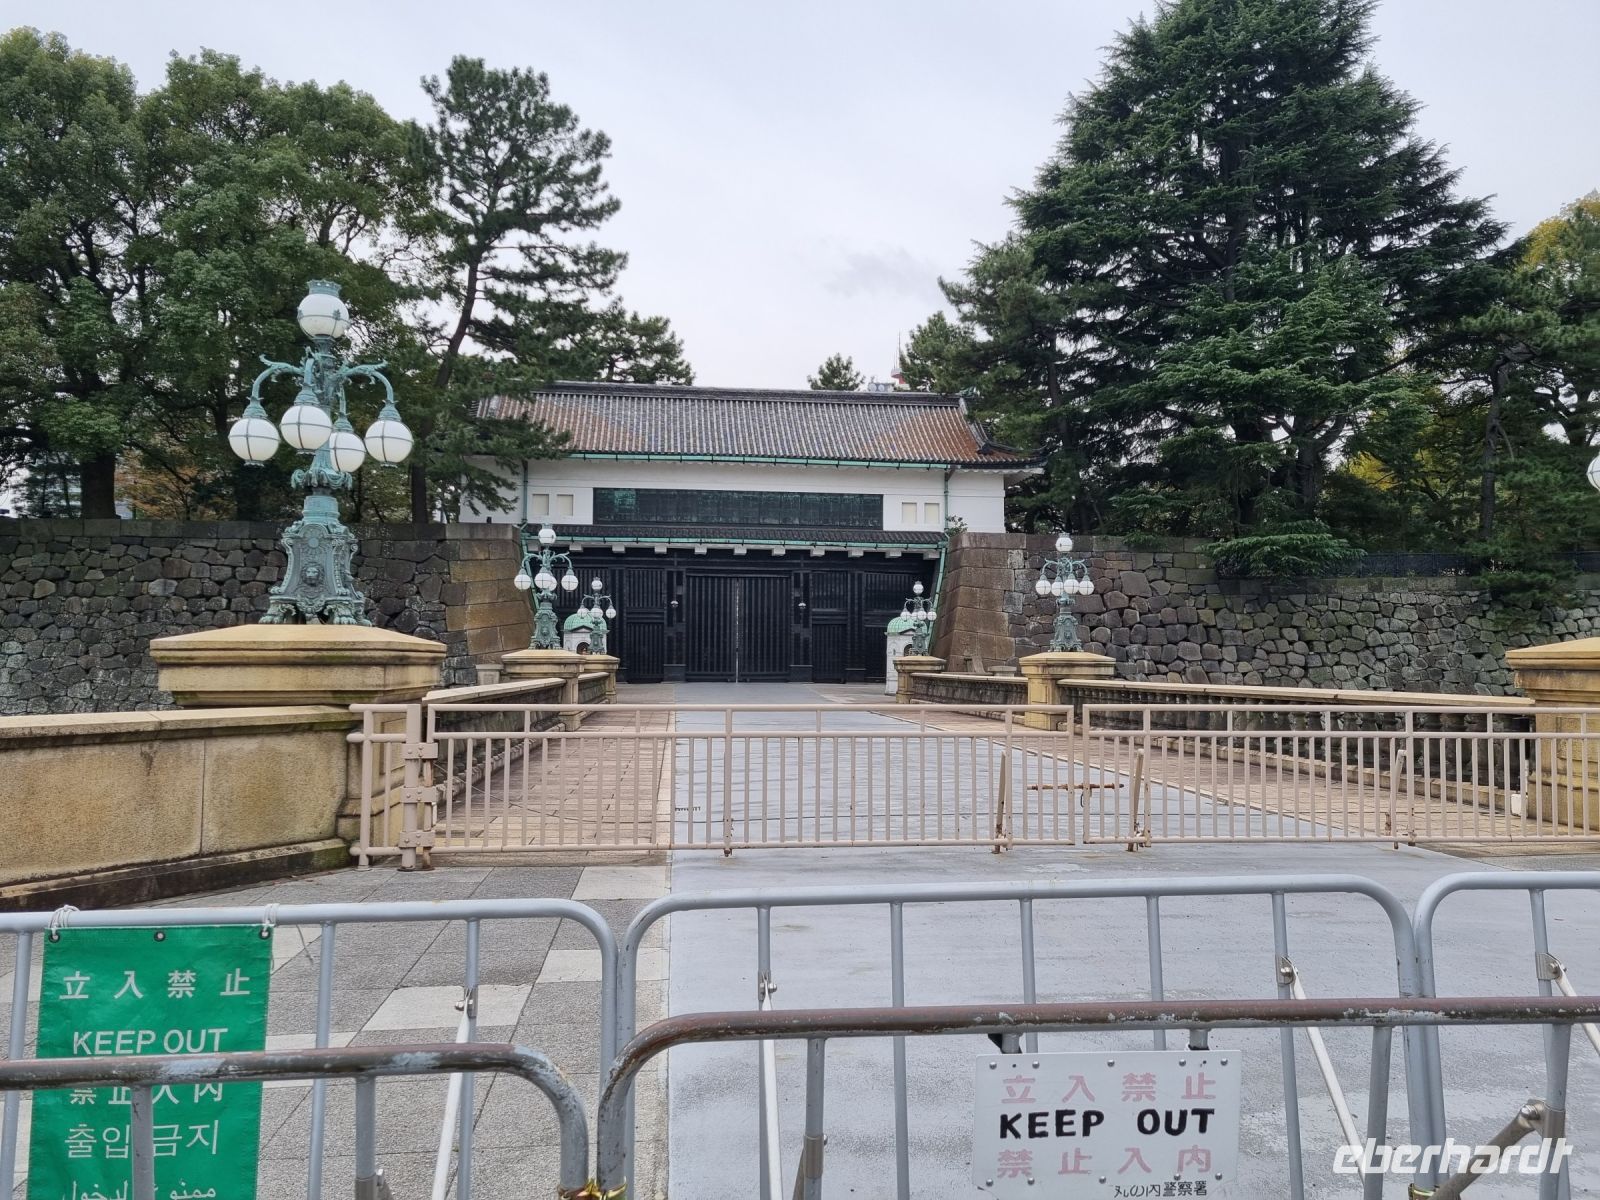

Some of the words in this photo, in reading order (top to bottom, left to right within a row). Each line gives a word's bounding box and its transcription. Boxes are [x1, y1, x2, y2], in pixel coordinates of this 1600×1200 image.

[59, 968, 251, 1000] 立入禁止
[73, 1029, 156, 1055] KEEP
[163, 1027, 229, 1054] OUT
[1001, 1072, 1216, 1104] 立入禁止
[999, 1109, 1105, 1140] KEEP
[1137, 1108, 1215, 1136] OUT
[997, 1144, 1213, 1178] 禁止入内
